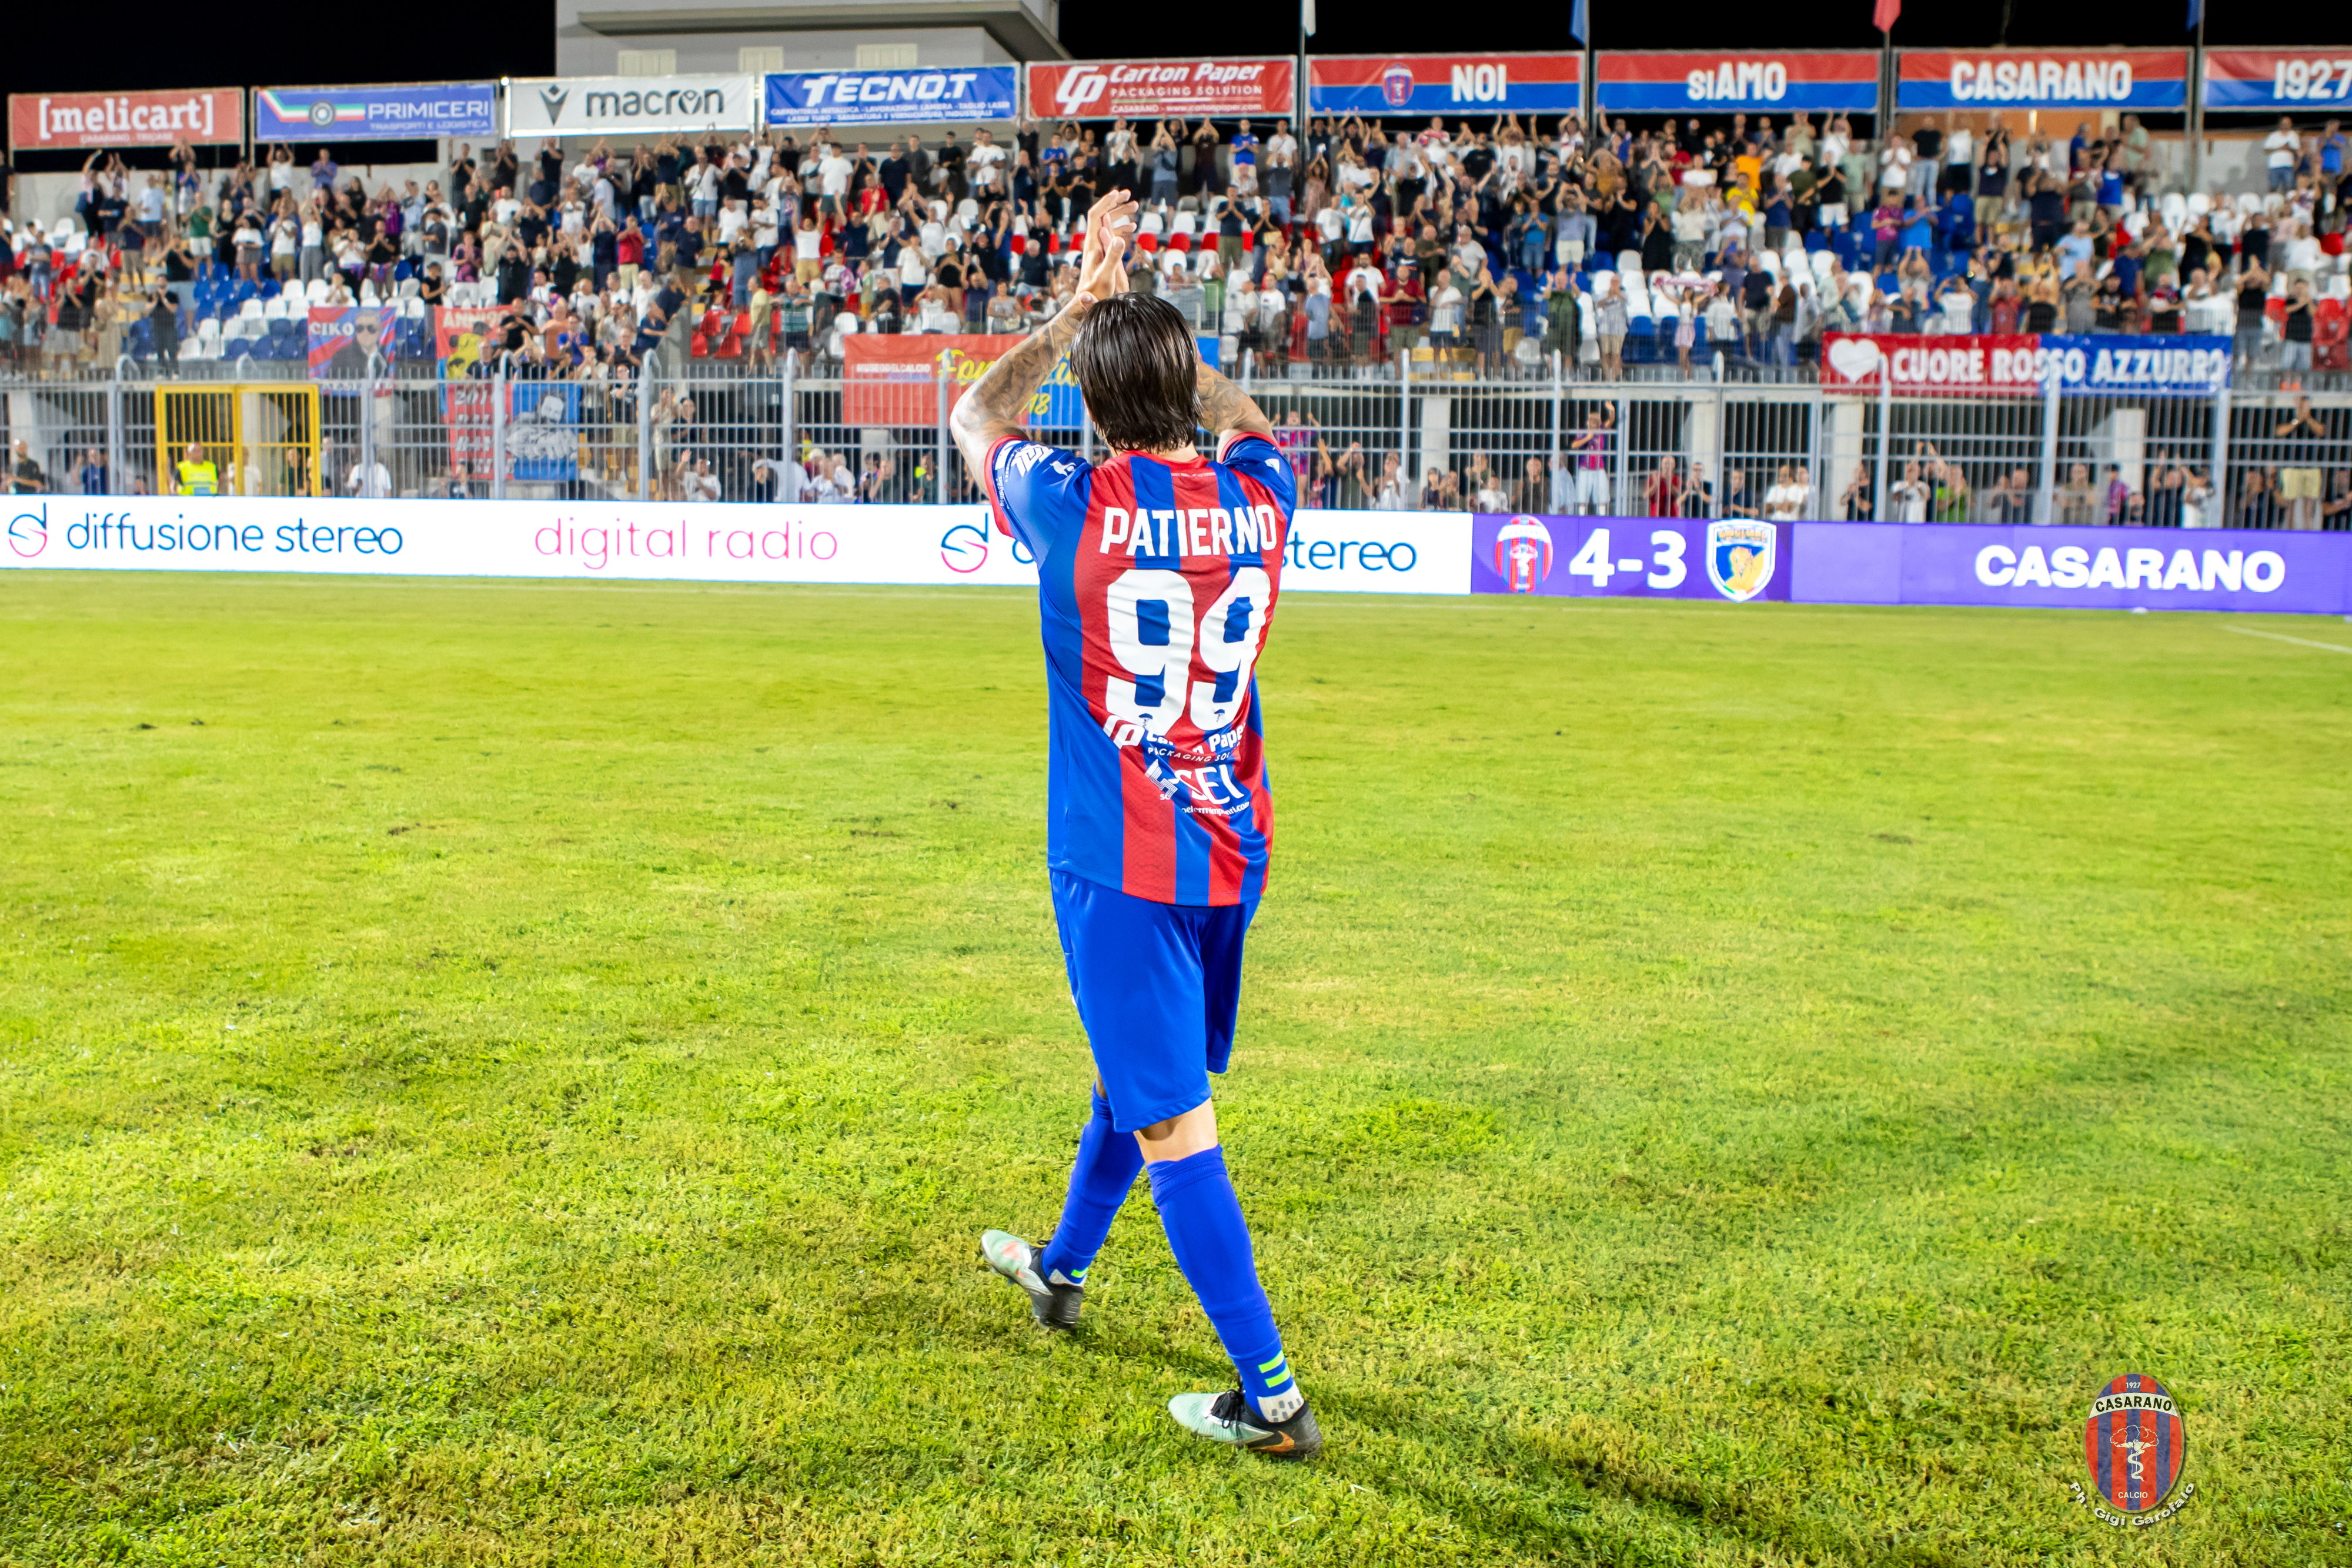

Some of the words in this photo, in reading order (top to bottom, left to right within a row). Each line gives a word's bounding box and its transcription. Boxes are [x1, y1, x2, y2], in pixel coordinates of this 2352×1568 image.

[1110, 65, 1191, 83] Carton
[1195, 62, 1265, 83] Paper
[1111, 86, 1191, 97] PACKAGING
[1197, 85, 1262, 96] SOLUTION
[1451, 64, 1506, 102] NOI
[1952, 61, 2132, 101] CASARANO
[2273, 59, 2352, 99] 1927
[368, 101, 489, 119] PRIMICERI
[586, 89, 724, 116] macron
[1111, 104, 1159, 113] CASARANO
[1167, 104, 1262, 112] www.cartonpaper.com
[309, 322, 355, 336] CIKO
[1892, 347, 1984, 383] CUORE
[1992, 347, 2086, 382] ROSSO
[2093, 347, 2225, 383] AZZURRO
[67, 512, 263, 551] diffusione
[276, 518, 403, 554] stereo
[534, 517, 686, 570] digital
[709, 520, 838, 560] radio
[1100, 504, 1277, 557] PATIERNO
[1975, 544, 2286, 593] CASARANO
[1105, 566, 1271, 737] 99
